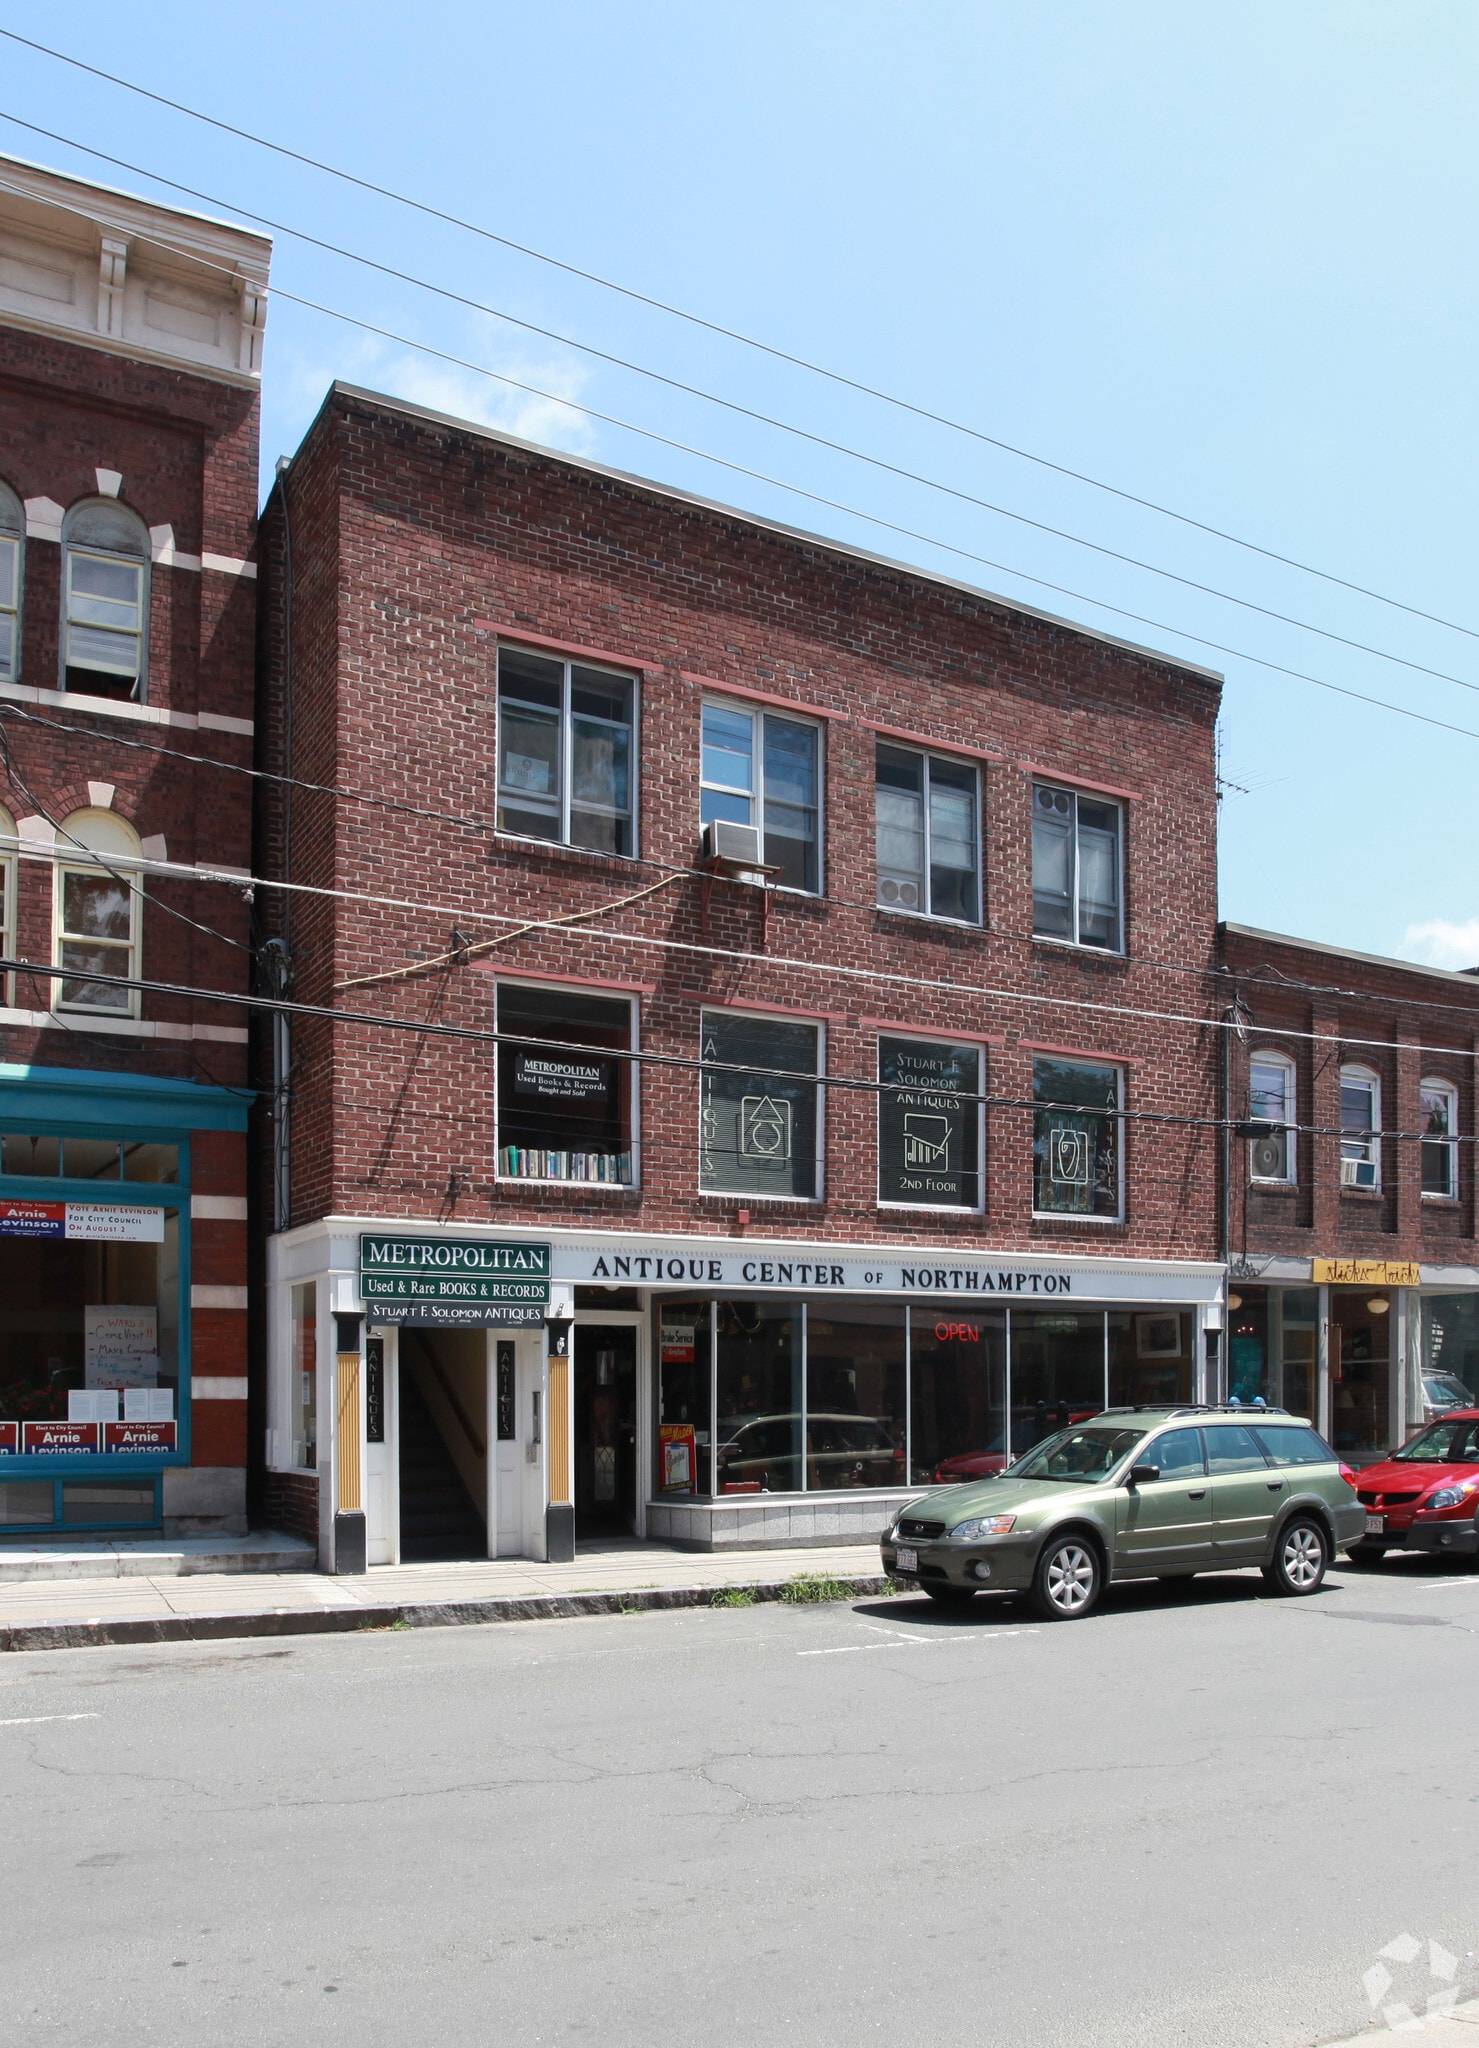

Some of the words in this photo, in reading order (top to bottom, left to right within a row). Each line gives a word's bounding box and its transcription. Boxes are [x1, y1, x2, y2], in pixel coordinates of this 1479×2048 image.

[524, 1059, 600, 1077] METROPOLITAN
[897, 1053, 945, 1071] STUART
[517, 1073, 536, 1083] Used
[538, 1077, 562, 1087] Books
[574, 1081, 606, 1091] Records
[897, 1070, 957, 1090] SOLOMON
[538, 1086, 559, 1095] Bought
[703, 1038, 718, 1171] ATIQUES
[896, 1093, 960, 1110] ANTIQUES
[1106, 1090, 1116, 1201] ATIQUES
[899, 1176, 922, 1189] 2ND
[926, 1178, 956, 1192] FLOOR
[7, 1208, 47, 1218] Arnie
[69, 1204, 89, 1212] VOTE
[120, 1207, 159, 1215] LEVINSON
[108, 1216, 142, 1224] COUNCIL
[368, 1242, 545, 1269] METROPOLITAN
[592, 1256, 723, 1281] ANTIQUE
[742, 1262, 845, 1285] CENTER
[864, 1271, 883, 1284] OF
[902, 1268, 1071, 1293] NORTHAMPTON
[368, 1279, 394, 1293] Used
[398, 1281, 406, 1294] &
[411, 1281, 436, 1295] Rare
[439, 1282, 477, 1296] BOOKS
[480, 1283, 488, 1296] &
[492, 1284, 546, 1298] RECORDS
[372, 1304, 417, 1317] STUART
[421, 1305, 428, 1317] F.
[431, 1305, 482, 1319] SOLOMON
[484, 1307, 541, 1322] ANTIQUES
[935, 1322, 979, 1342] OPEN
[42, 1431, 80, 1443] Arnie
[122, 1430, 159, 1442] Arnie
[32, 1444, 91, 1454] Levinson
[112, 1443, 169, 1453] Levinson
